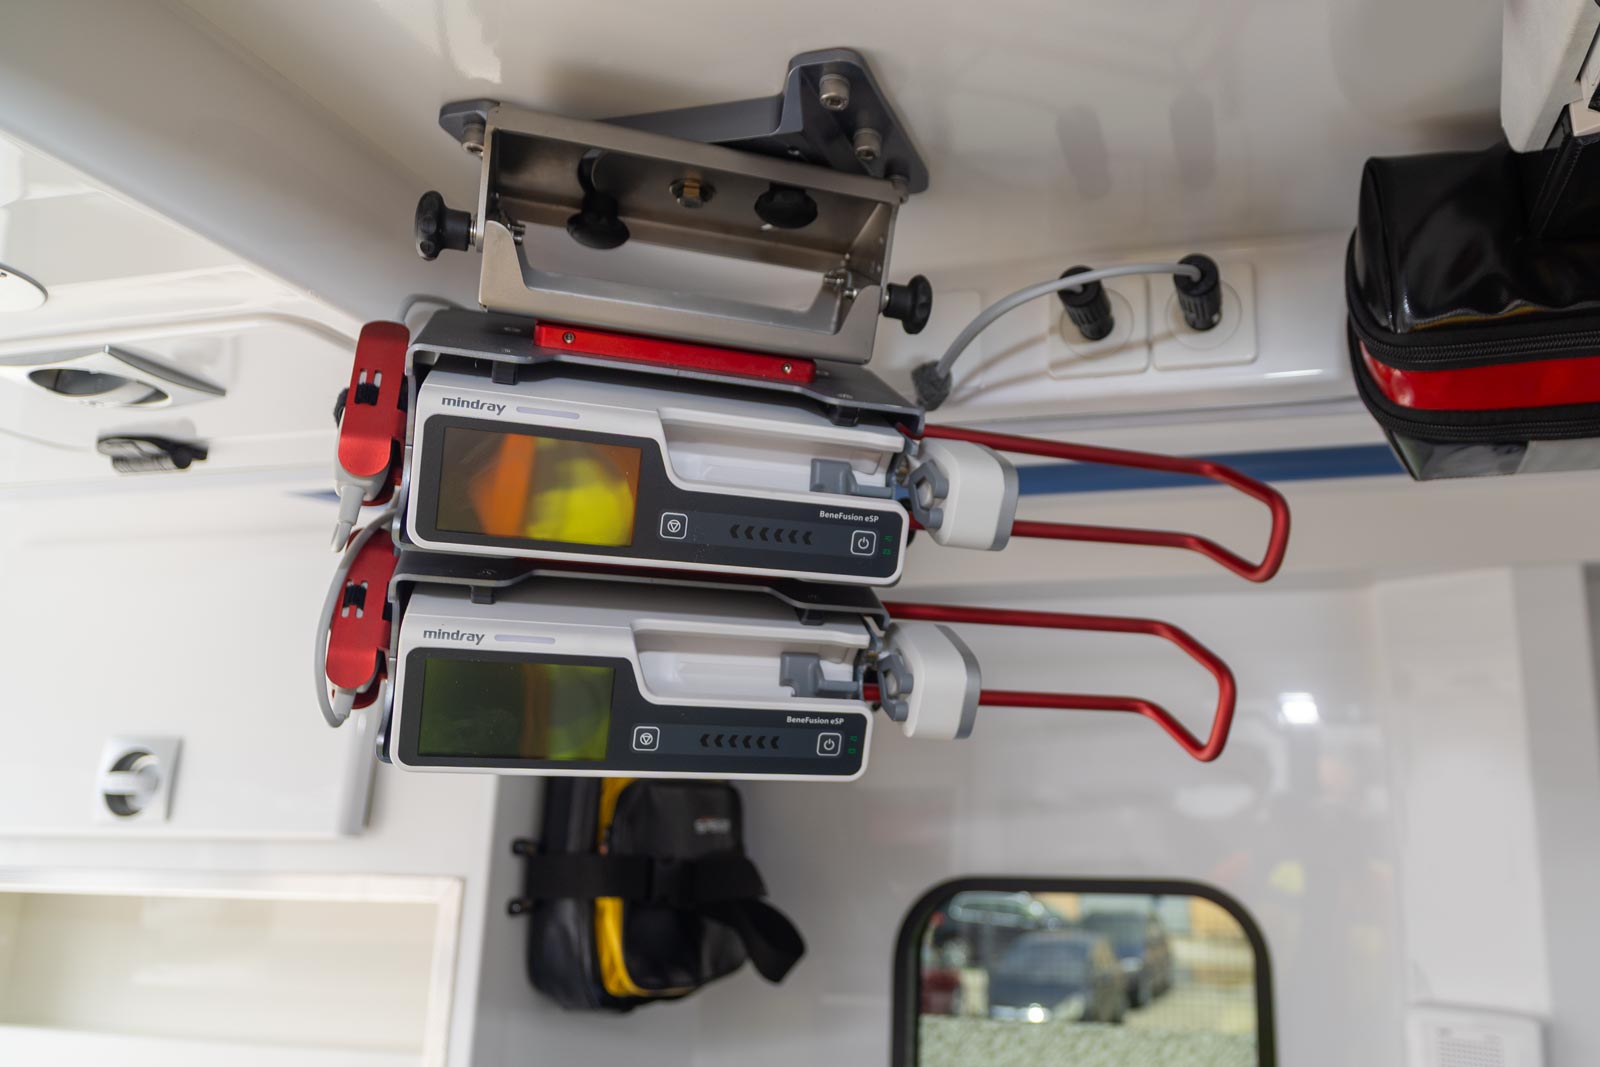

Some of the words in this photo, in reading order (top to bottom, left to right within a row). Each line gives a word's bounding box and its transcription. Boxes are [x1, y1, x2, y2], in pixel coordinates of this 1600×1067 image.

[441, 397, 506, 415] mindray
[819, 510, 864, 522] BeneFusion
[864, 515, 879, 523] eSP
[423, 629, 485, 645] mindray
[787, 715, 829, 725] BeneFusion
[830, 717, 845, 725] eSP
